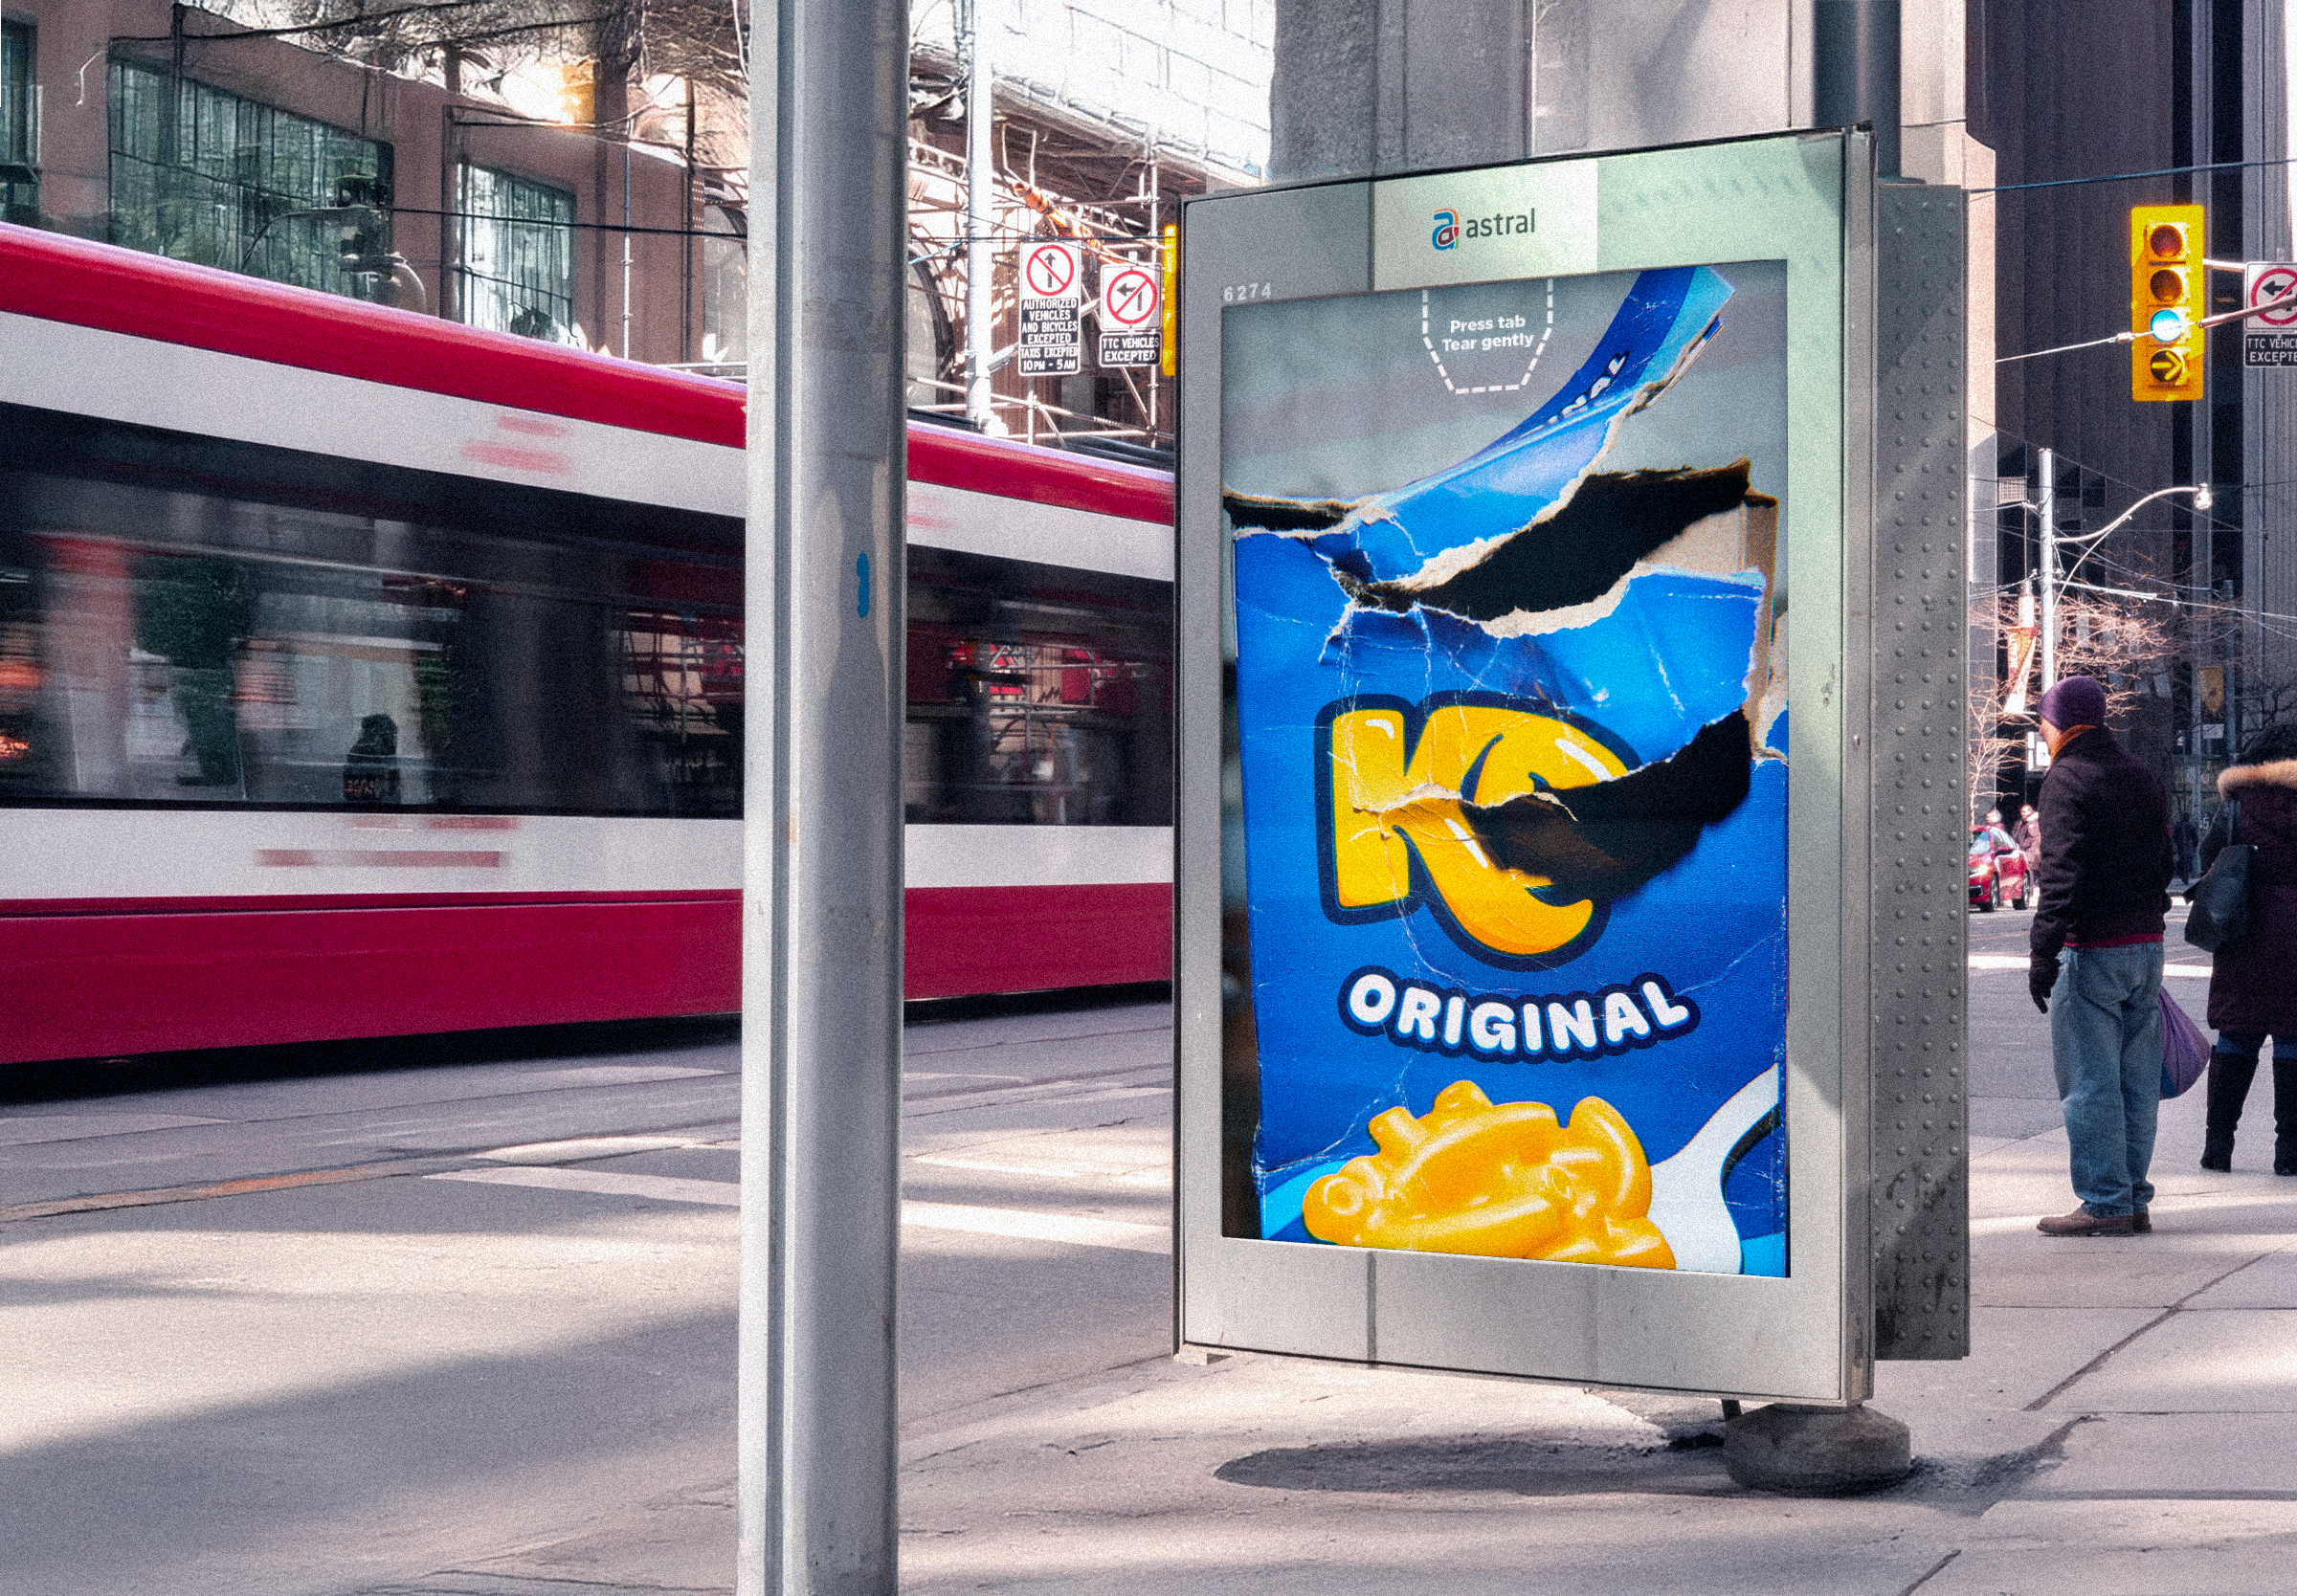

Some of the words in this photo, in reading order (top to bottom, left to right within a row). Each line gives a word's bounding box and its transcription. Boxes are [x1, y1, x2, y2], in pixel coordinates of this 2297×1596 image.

[1466, 208, 1536, 238] astral
[1224, 282, 1272, 302] 6274
[1023, 299, 1078, 310] AUTHORIZED
[1029, 310, 1071, 321] VEHICLES
[1022, 322, 1038, 333] AND
[1041, 321, 1078, 333] BICYCLES
[1450, 318, 1494, 334] Press
[1498, 315, 1527, 330] tab
[1028, 333, 1072, 344] EXCEPTED
[1103, 338, 1120, 349] TTC
[1122, 337, 1160, 348] VEHICLES
[1441, 337, 1478, 353] Tear
[1482, 332, 1534, 351] gently
[2247, 338, 2266, 349] TTC
[1021, 347, 1041, 359] TAXIS
[1044, 346, 1079, 358] EXCEPTED
[1104, 349, 1157, 363] EXCEPTED
[1349, 972, 1691, 1053] ORIGINAL
